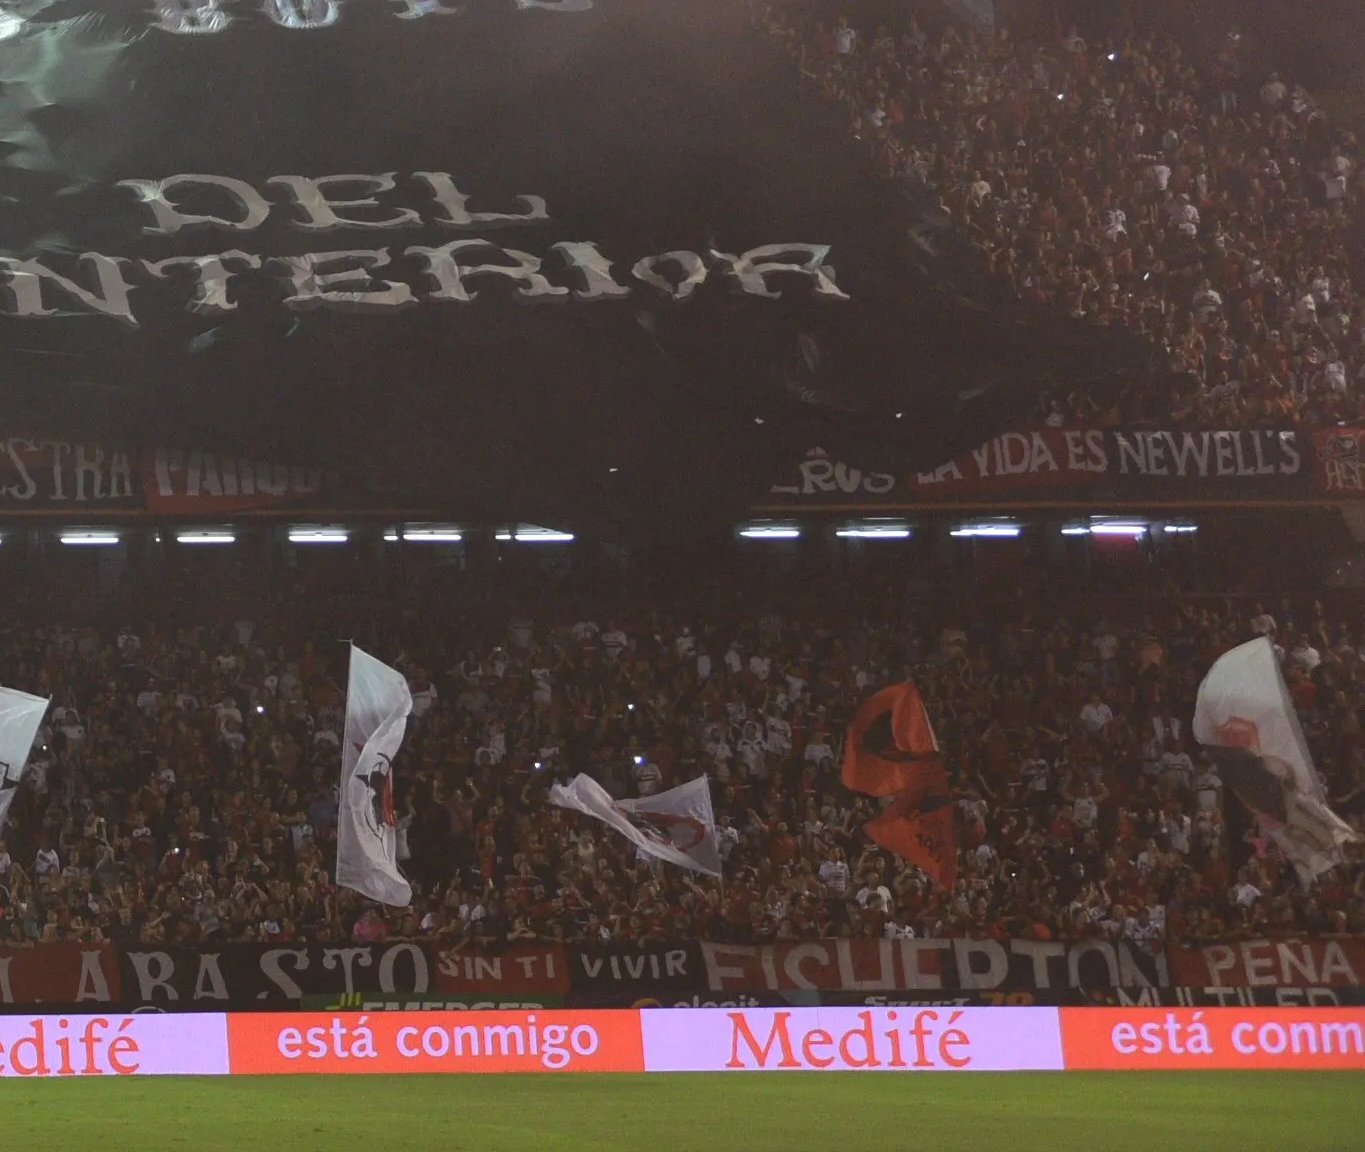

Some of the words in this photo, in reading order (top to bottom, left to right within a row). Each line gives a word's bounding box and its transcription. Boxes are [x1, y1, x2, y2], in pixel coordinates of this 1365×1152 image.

[114, 170, 549, 235] DEL
[971, 430, 1060, 478] VIDA
[1064, 428, 1109, 474] ES
[1112, 429, 1302, 476] NEWELL'S
[437, 949, 503, 980] SIN
[515, 953, 556, 979] TI
[580, 949, 688, 980] VIVIR
[1202, 937, 1360, 987] PEÑA
[276, 1016, 378, 1059] está
[396, 1021, 600, 1069] conmigo
[726, 1009, 972, 1068] Medifé
[1111, 1011, 1214, 1055] está
